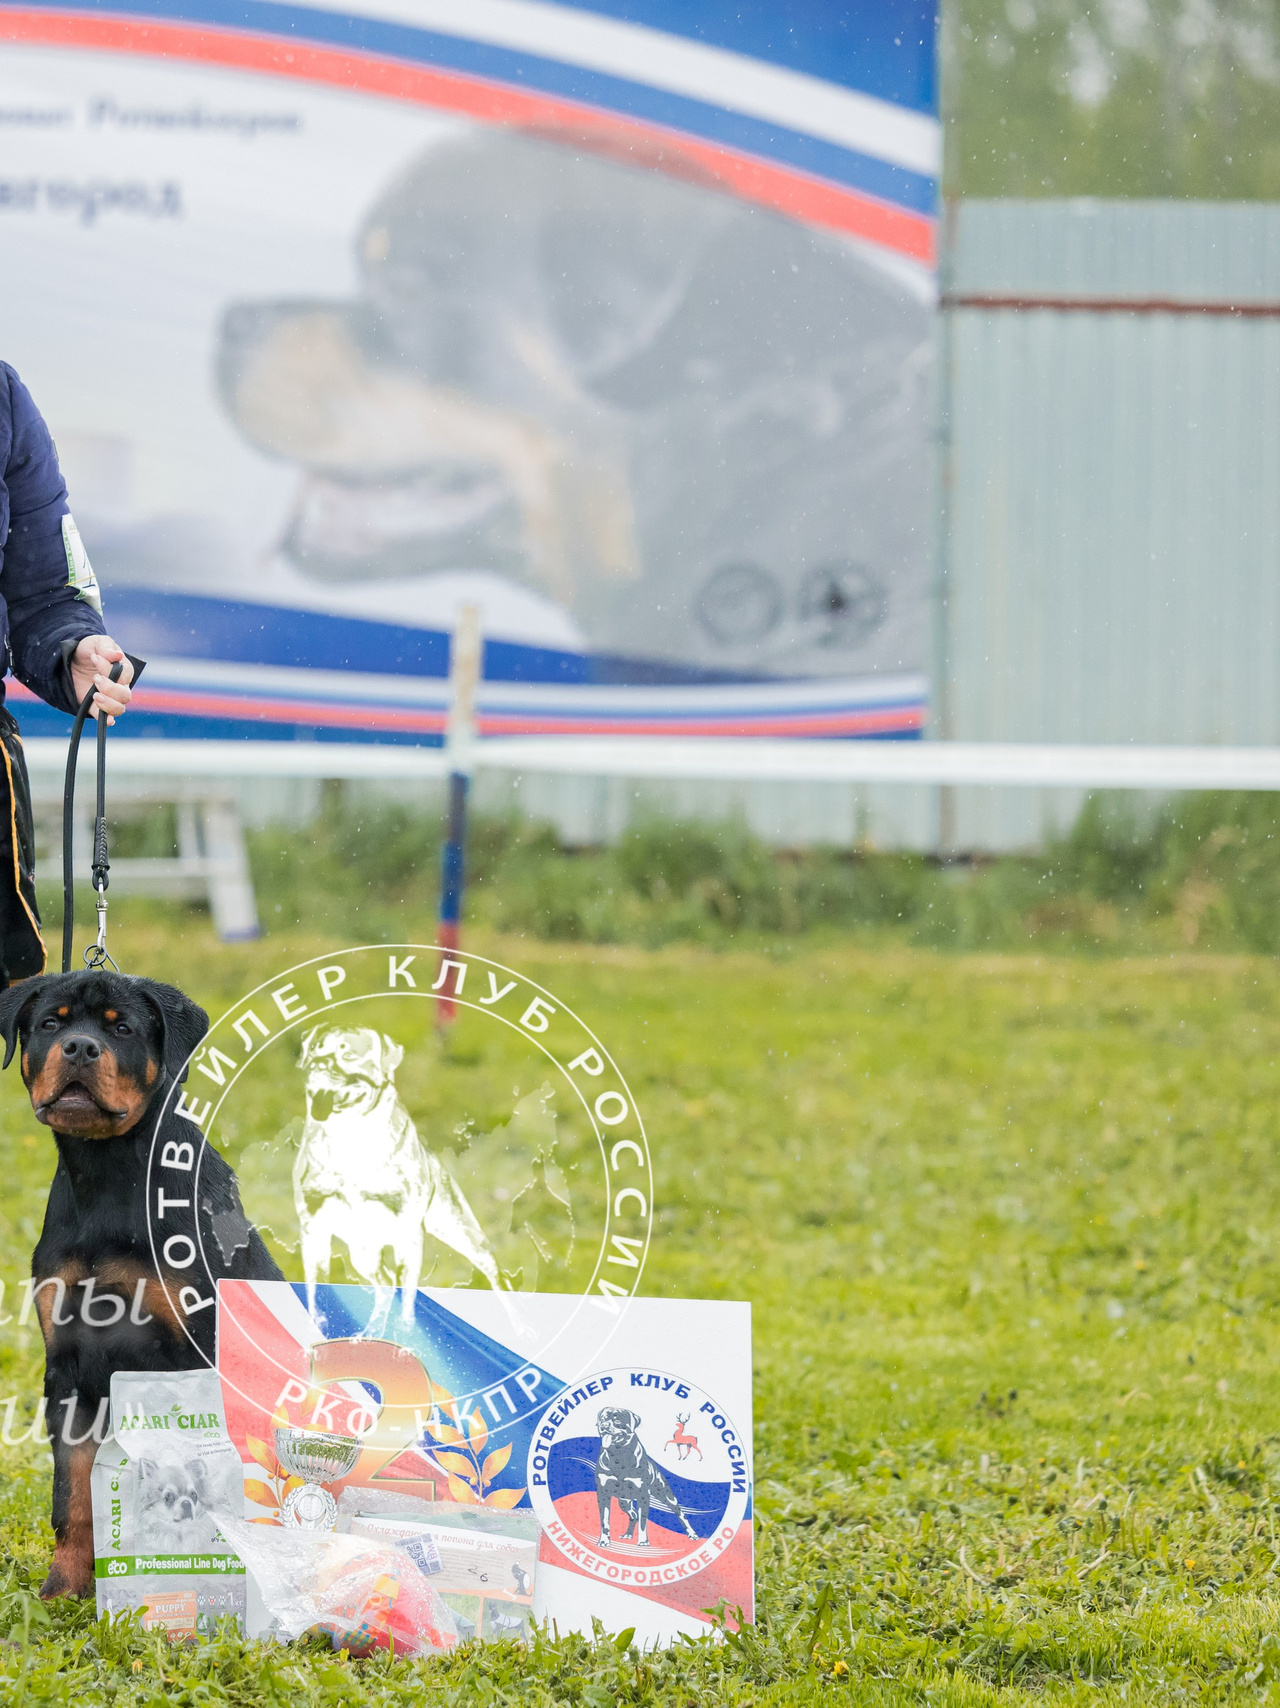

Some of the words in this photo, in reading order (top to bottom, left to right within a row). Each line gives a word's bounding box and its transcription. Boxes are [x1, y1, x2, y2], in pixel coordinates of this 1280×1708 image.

[119, 1415, 170, 1430] ACARI
[177, 1412, 220, 1430] CIAR
[532, 1375, 614, 1486] РОТВЕЙЛЕР
[630, 1373, 692, 1400] КЛУБ
[699, 1401, 746, 1493] РОССИИ
[111, 1498, 122, 1551] ACARI
[546, 1520, 713, 1585] НИЖЕГОРОДСКОЕ
[712, 1526, 735, 1551] РО
[108, 1559, 128, 1575] eco
[135, 1557, 191, 1570] Professional
[193, 1557, 211, 1570] Line
[212, 1557, 226, 1571] Dog
[227, 1557, 246, 1570] Food
[155, 1602, 186, 1614] PUPPY
